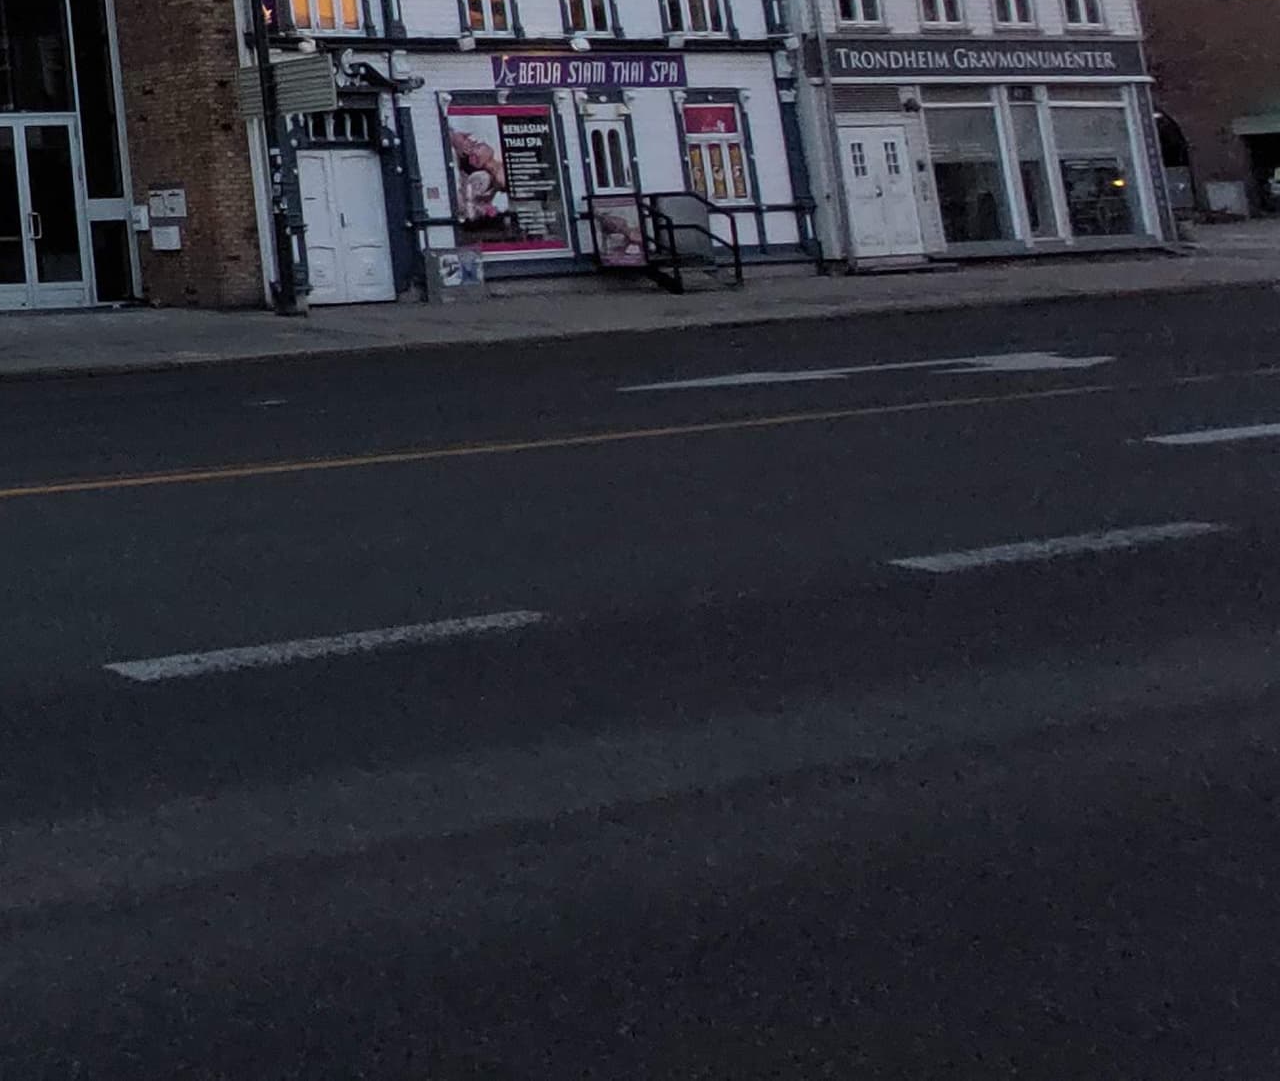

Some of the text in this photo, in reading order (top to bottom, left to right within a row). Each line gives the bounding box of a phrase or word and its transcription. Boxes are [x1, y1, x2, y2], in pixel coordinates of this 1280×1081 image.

[519, 61, 679, 85] BENJA SIAM THAI SPA
